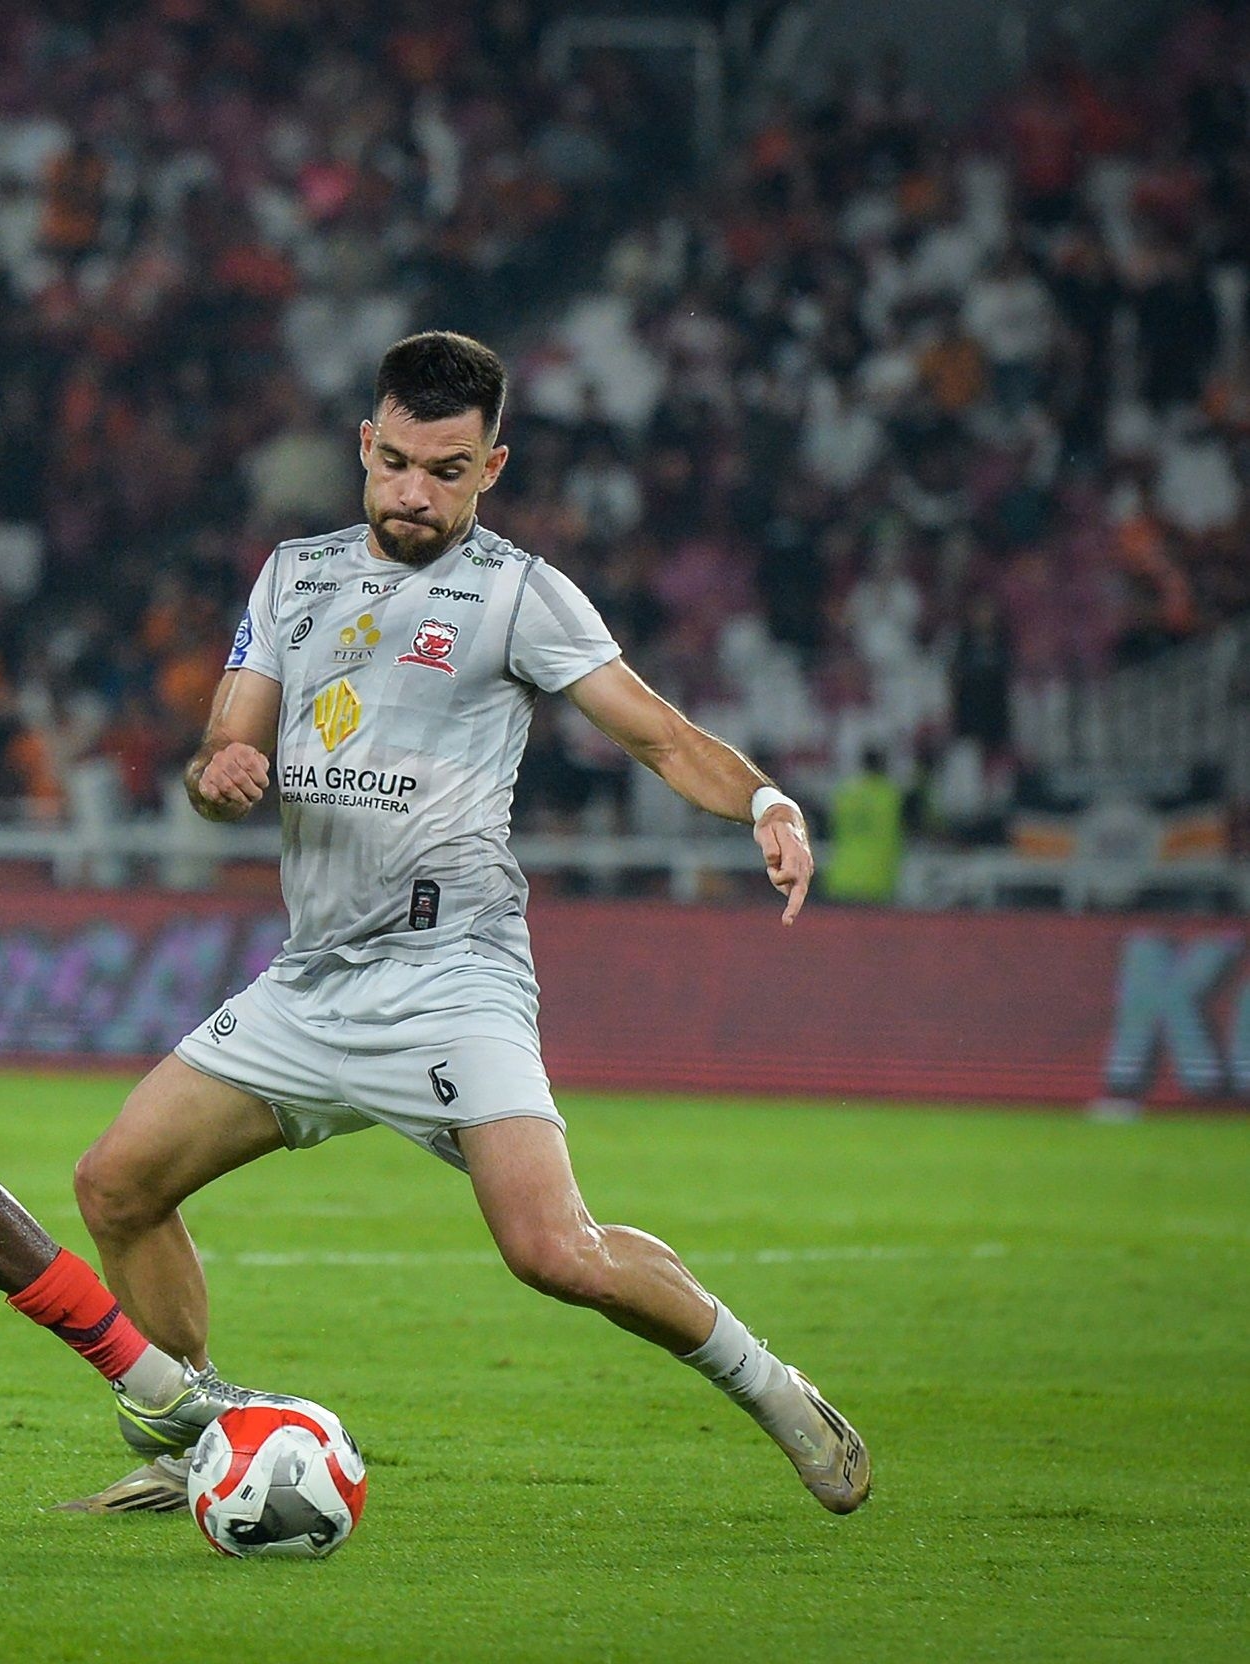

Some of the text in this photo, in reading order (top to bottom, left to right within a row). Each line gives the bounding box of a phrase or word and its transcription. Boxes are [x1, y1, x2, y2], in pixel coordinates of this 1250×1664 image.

[333, 650, 375, 661] TITAN
[325, 766, 418, 798] GROUP
[304, 792, 337, 806] AGRO
[338, 794, 410, 814] SEJAHTERA
[427, 1059, 459, 1107] 6
